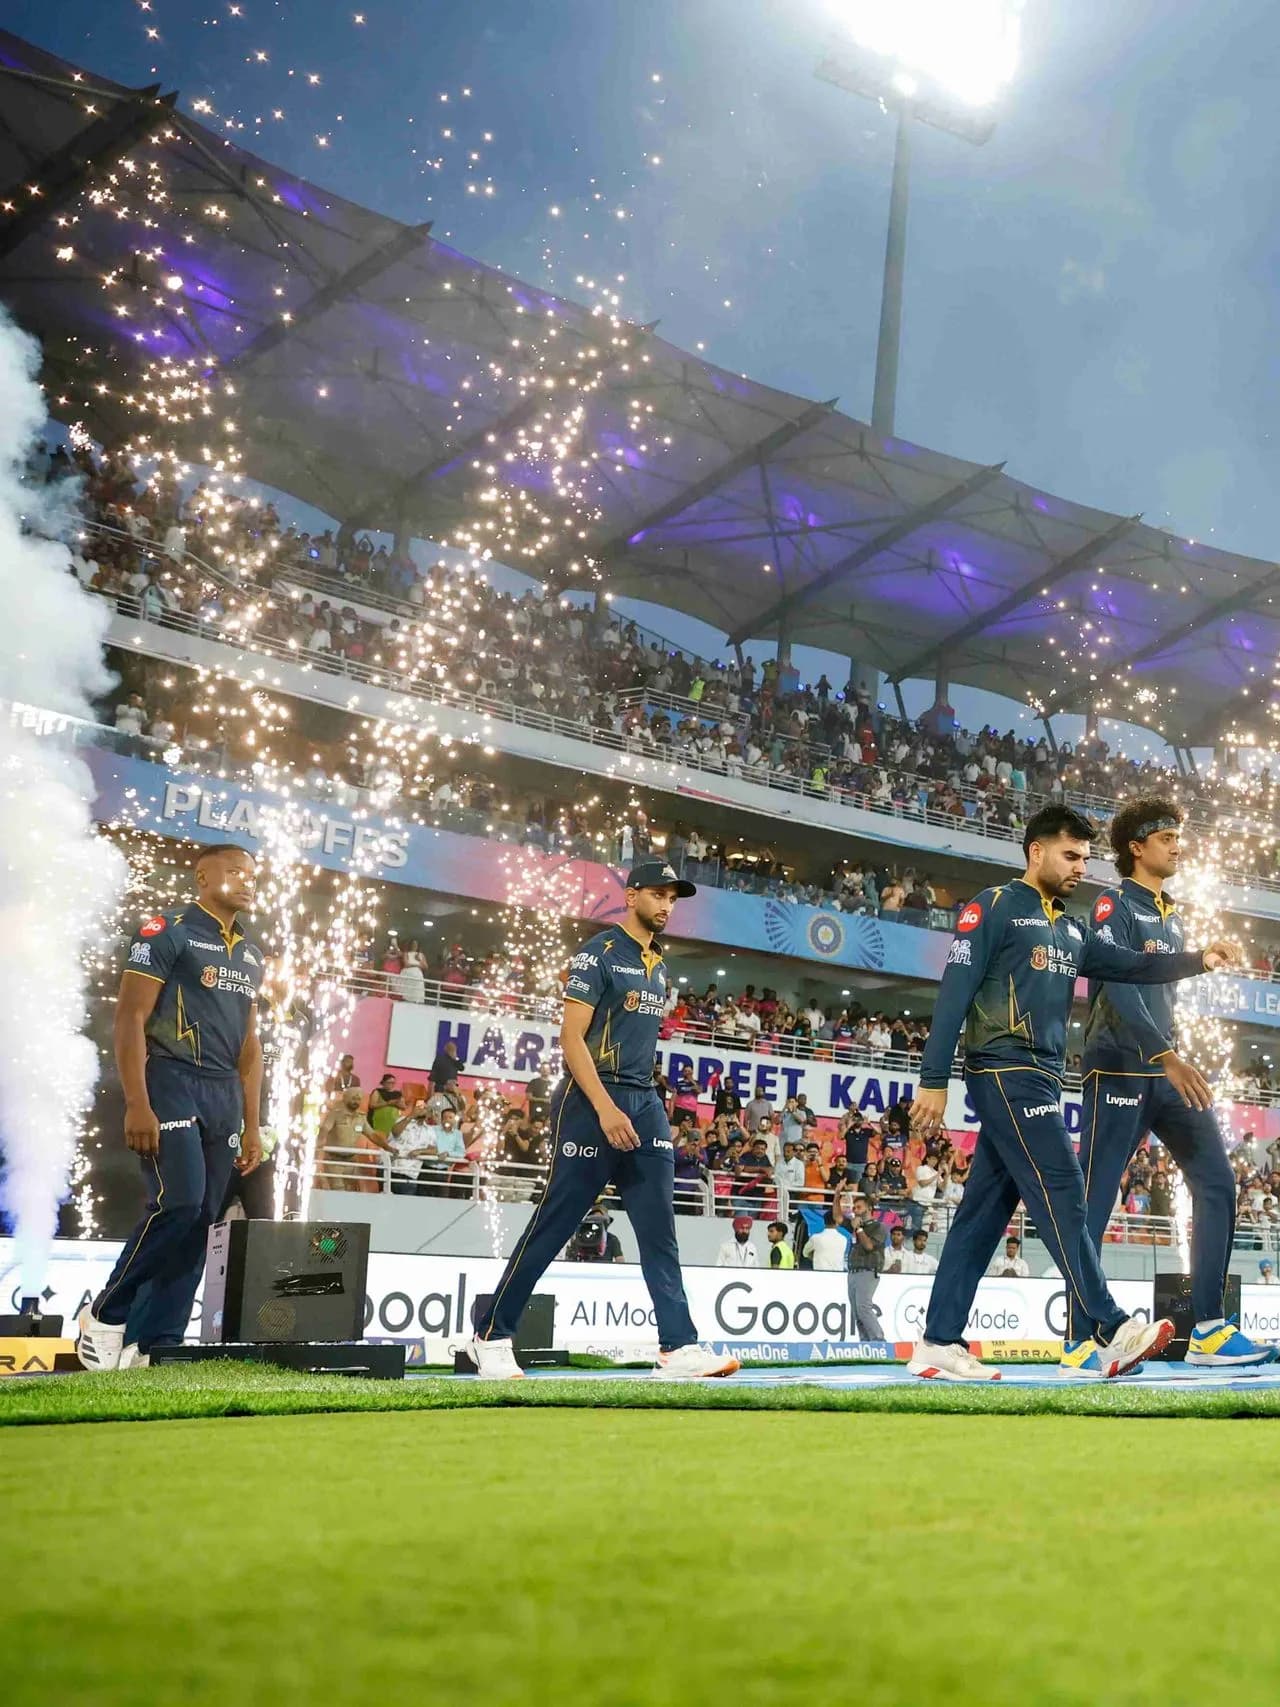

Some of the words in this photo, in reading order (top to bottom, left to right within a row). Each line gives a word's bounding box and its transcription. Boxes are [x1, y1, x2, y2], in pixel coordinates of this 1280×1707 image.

[163, 782, 409, 868] PLAOFFS
[1096, 901, 1111, 917] Jio
[959, 910, 978, 924] Jio
[1011, 918, 1050, 928] TORRENT
[143, 919, 162, 932] Jio
[187, 939, 226, 953] TORRENT
[219, 966, 251, 983] BIRLA
[830, 1073, 914, 1113] KAU
[579, 1146, 599, 1158] IGI
[570, 1300, 597, 1327] AI
[992, 1349, 1053, 1358] SIERRA
